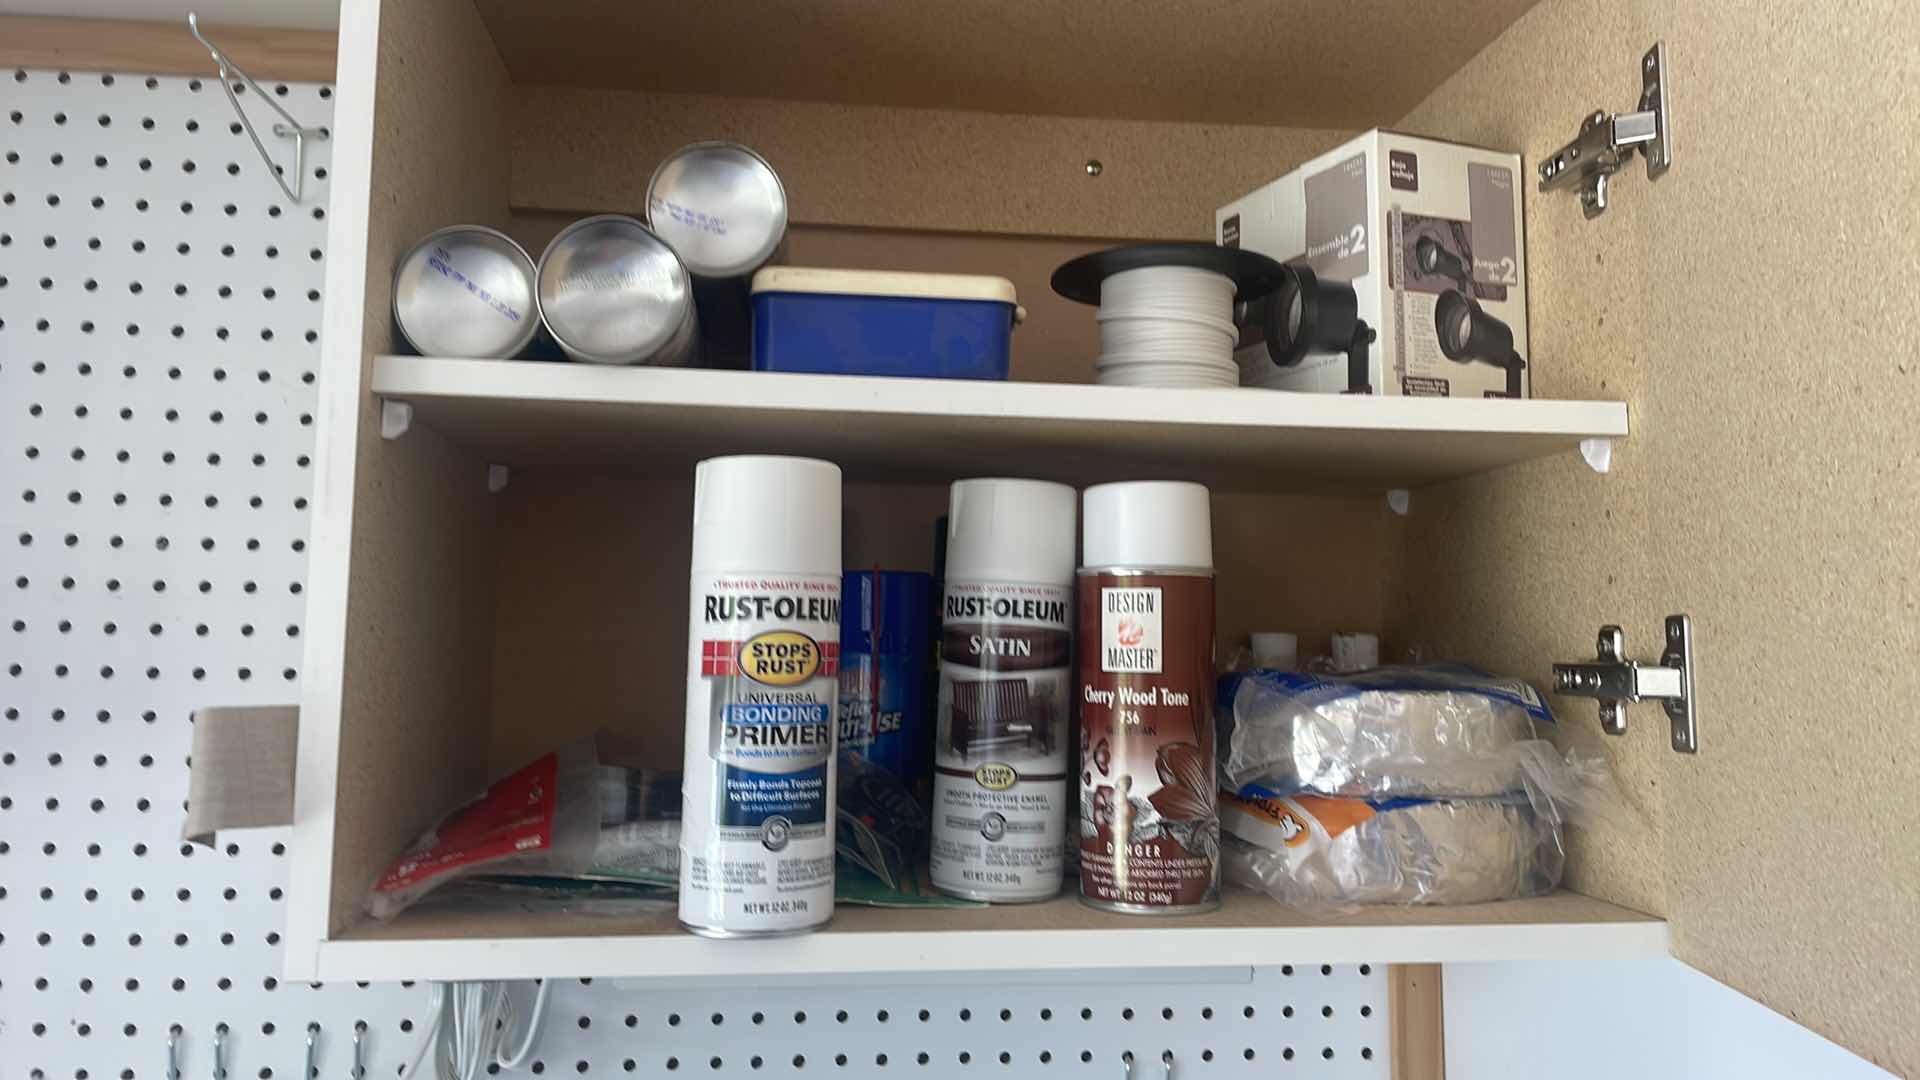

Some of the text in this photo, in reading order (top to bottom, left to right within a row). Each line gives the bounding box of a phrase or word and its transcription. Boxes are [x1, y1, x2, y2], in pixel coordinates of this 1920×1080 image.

[1308, 234, 1349, 258] Ensemble
[1338, 224, 1365, 260] de 2
[1474, 256, 1500, 272] Juego
[1488, 257, 1516, 283] de 2
[946, 595, 1065, 624] RUST-OLEUM
[1108, 592, 1154, 614] DESIGN
[752, 642, 812, 657] STOPS
[969, 634, 1031, 657] SATIN
[757, 659, 809, 675] RUST
[1108, 648, 1154, 670] MASTER
[736, 690, 818, 705] UNIVERSAL
[1084, 684, 1189, 709] Cherry Wood Tone
[732, 706, 822, 723] BONDING
[1119, 710, 1140, 725] 756
[725, 724, 829, 746] PRIMER
[981, 768, 1012, 777] STOPS
[727, 778, 757, 791] Firmly
[759, 779, 789, 790] Bonds
[983, 777, 1007, 785] RUST
[730, 790, 820, 802] to Difficult Surfaces
[973, 791, 1018, 802] PROTECTIVE
[1106, 842, 1161, 858] DNGER
